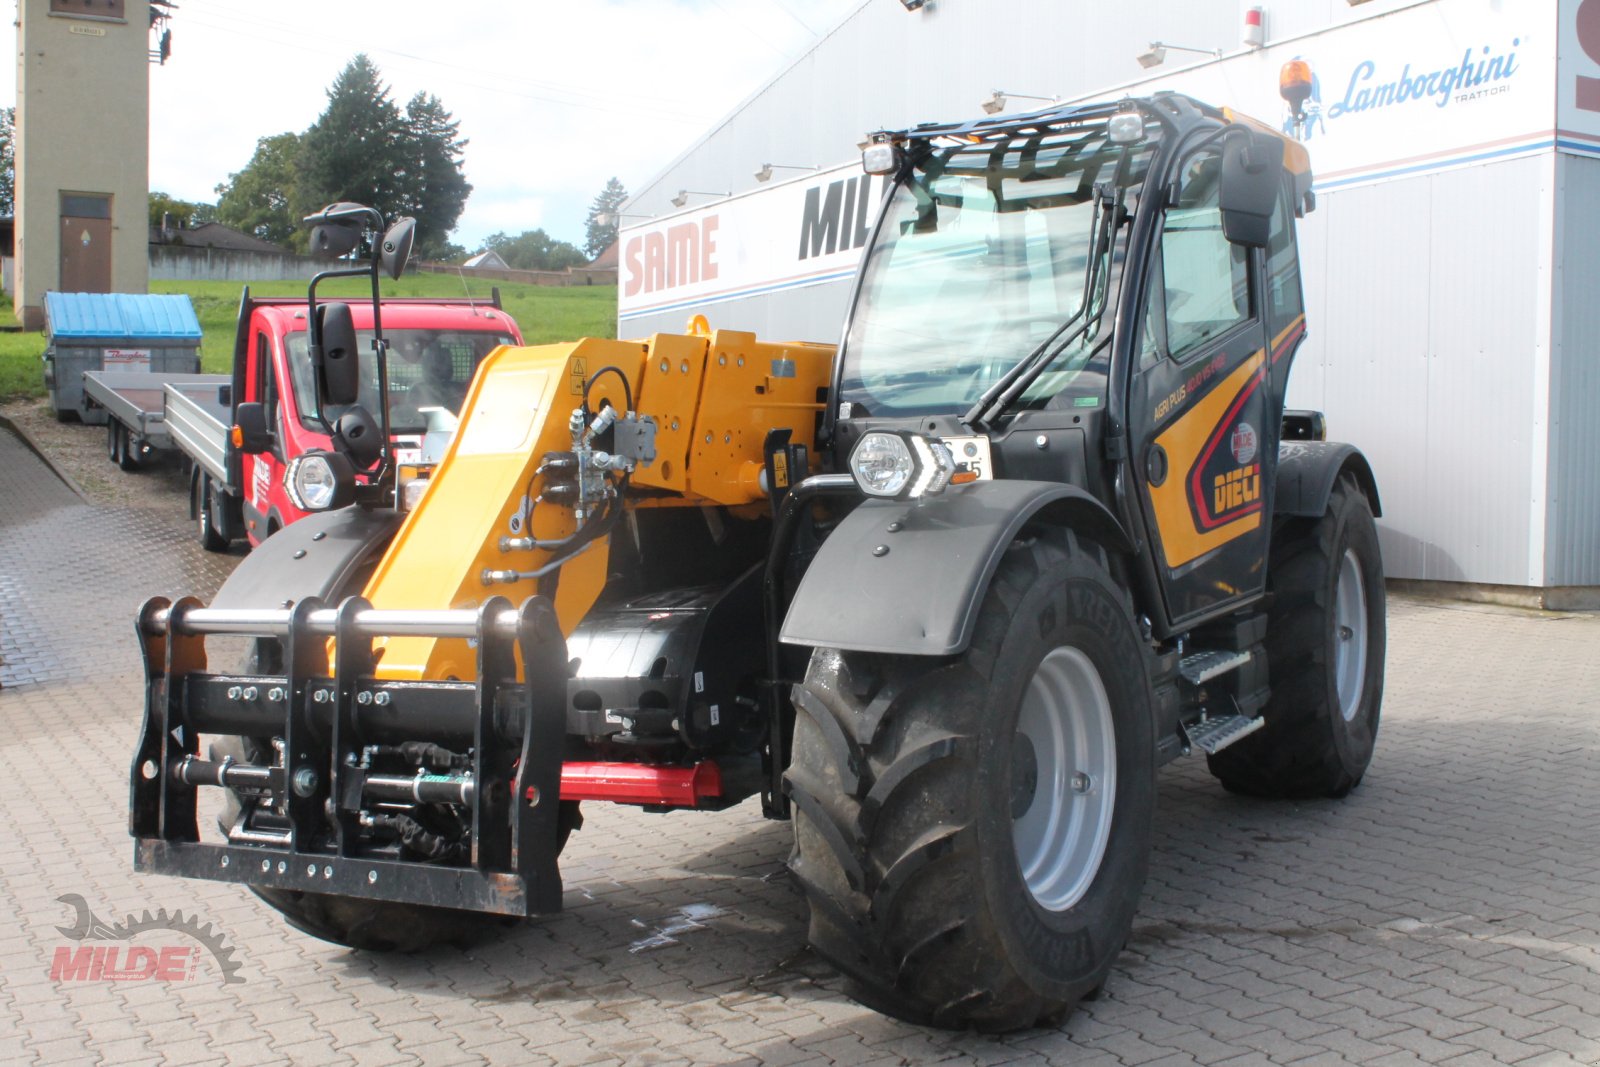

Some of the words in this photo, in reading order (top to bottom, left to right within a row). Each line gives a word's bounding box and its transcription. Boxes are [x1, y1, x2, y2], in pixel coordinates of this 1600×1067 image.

[1327, 37, 1520, 119] Lamborghini
[1454, 84, 1510, 104] TRATTORI
[798, 174, 893, 261] MIL
[624, 214, 719, 298] SAME
[1153, 397, 1170, 423] AGRI
[1169, 384, 1186, 409] PLUS
[1214, 463, 1261, 515] DIECI
